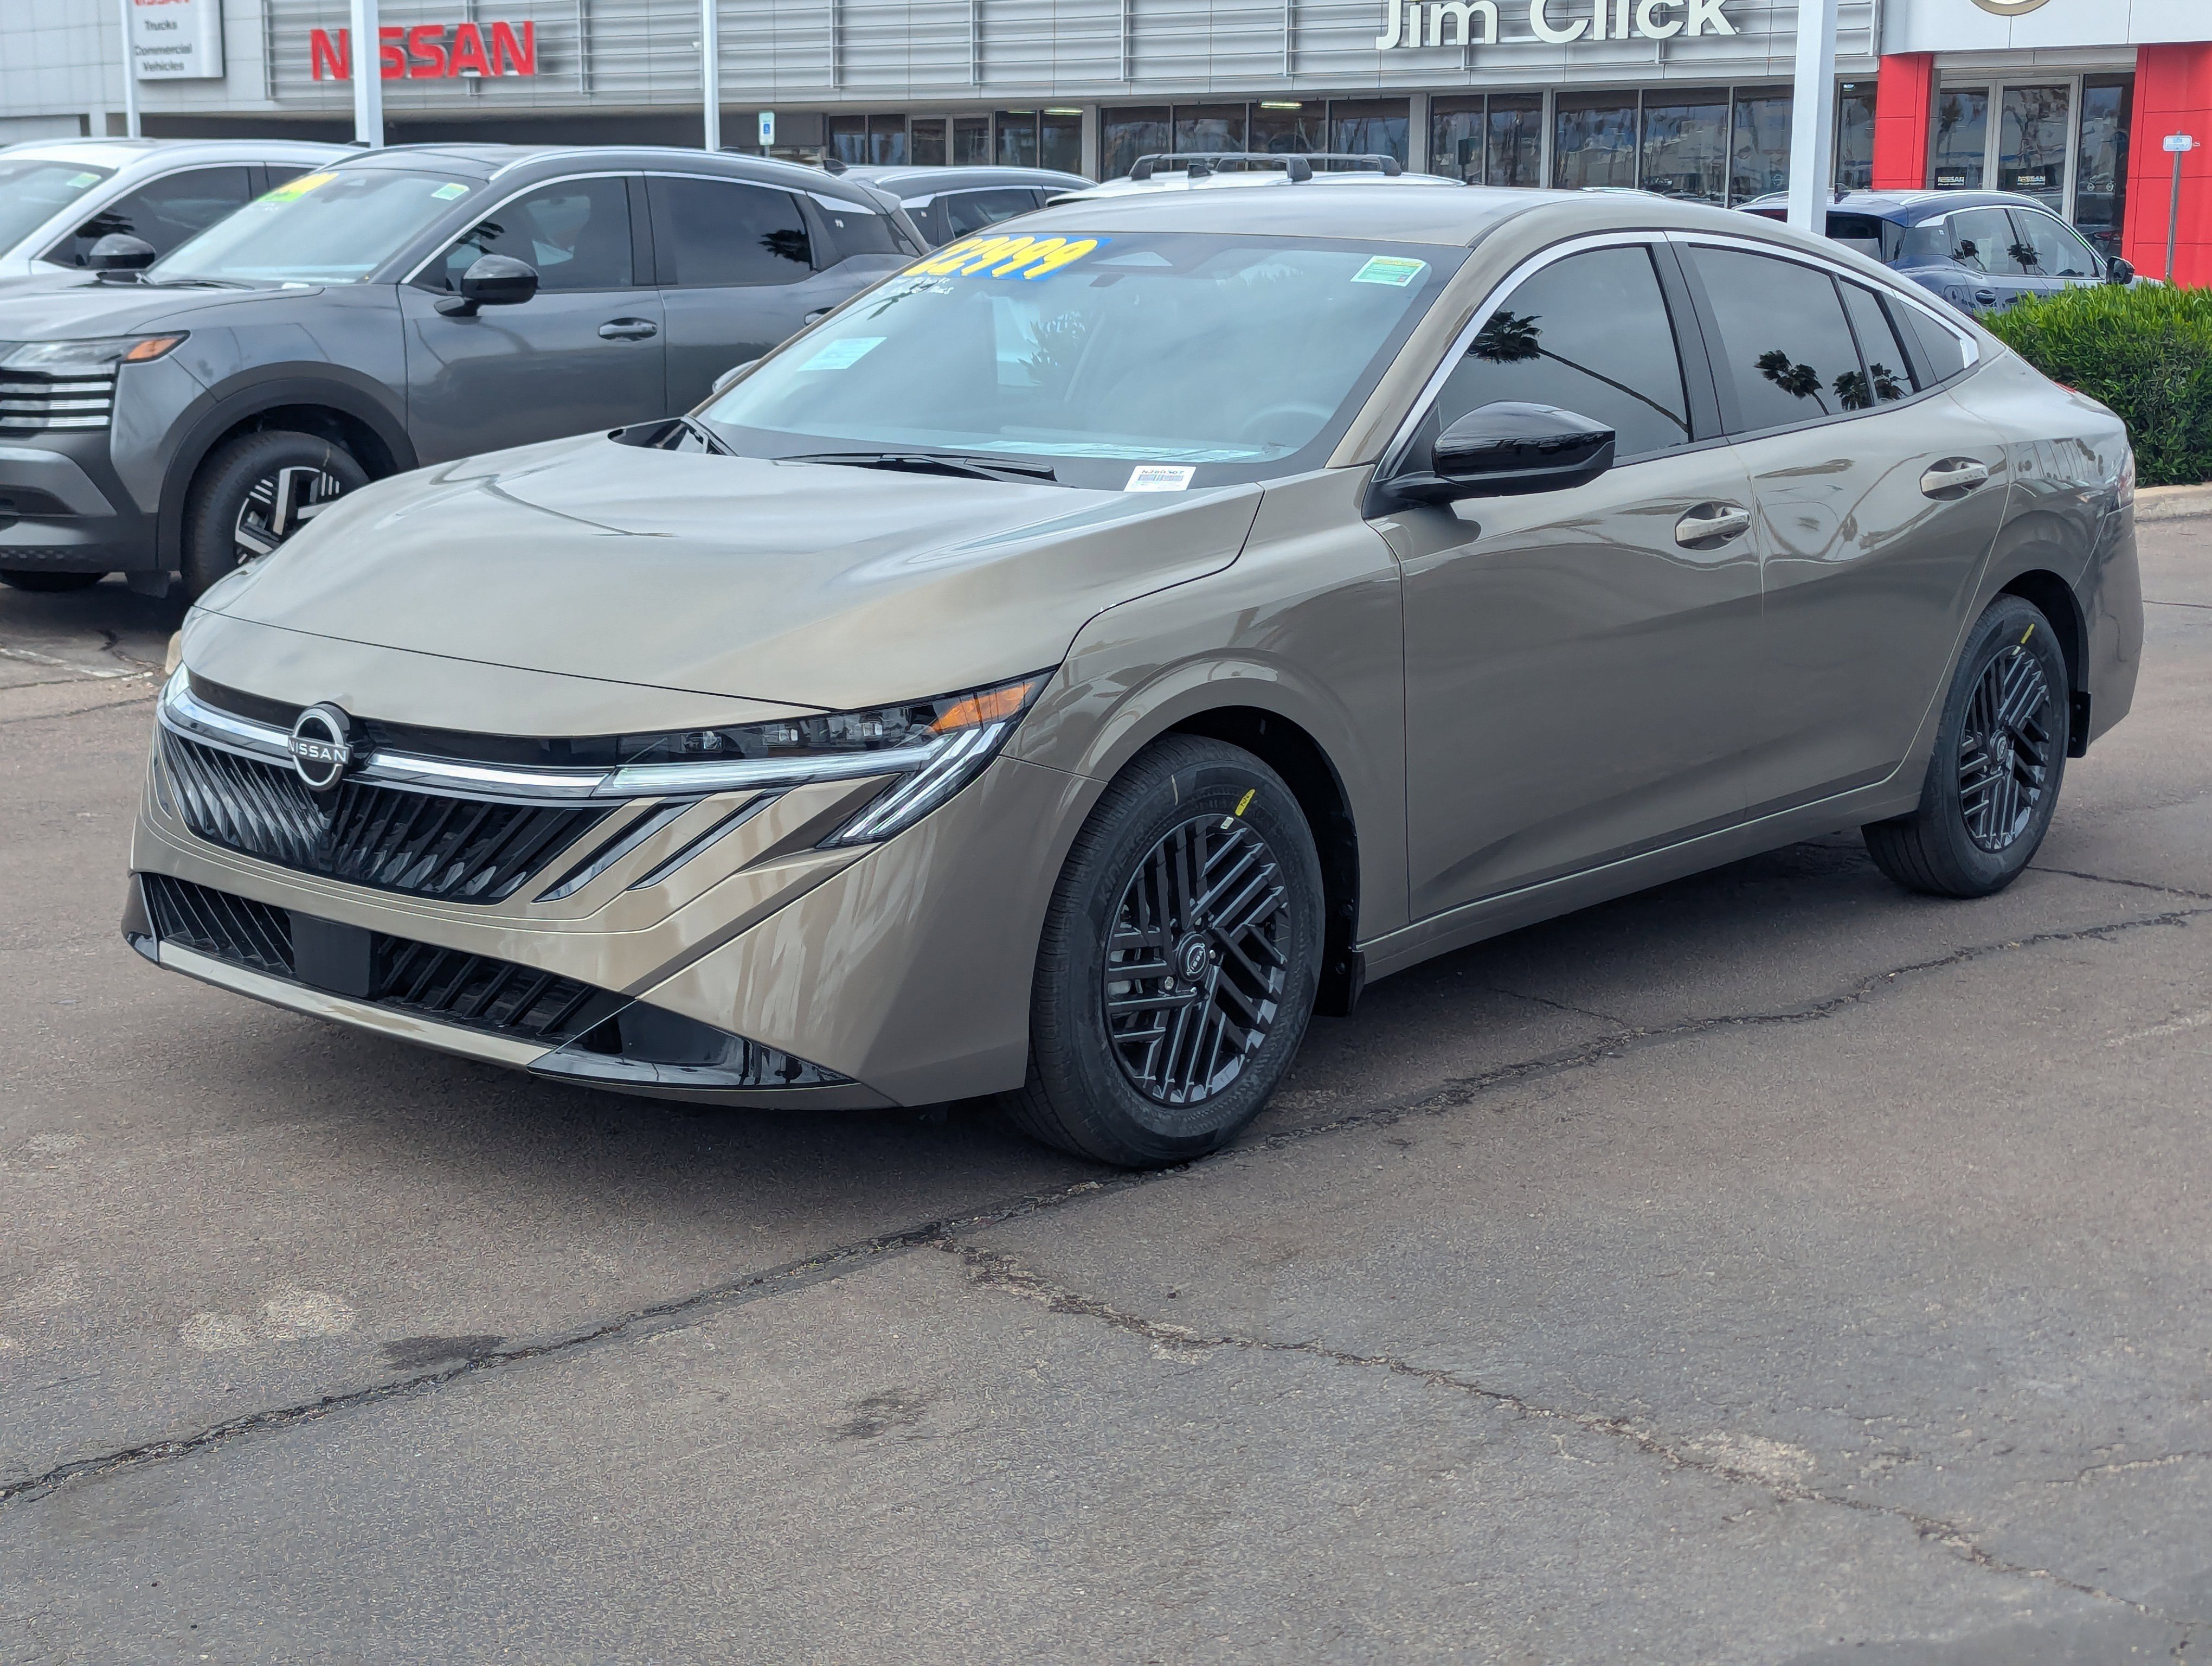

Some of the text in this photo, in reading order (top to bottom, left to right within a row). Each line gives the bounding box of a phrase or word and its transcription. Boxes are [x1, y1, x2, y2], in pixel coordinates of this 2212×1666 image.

[145, 20, 178, 30] Trucks
[1375, 0, 1738, 50] Jim Click
[134, 43, 192, 55] Commercial
[311, 21, 534, 81] NSSAN
[143, 60, 184, 72] Vehicles
[288, 738, 347, 762] NISSAN
